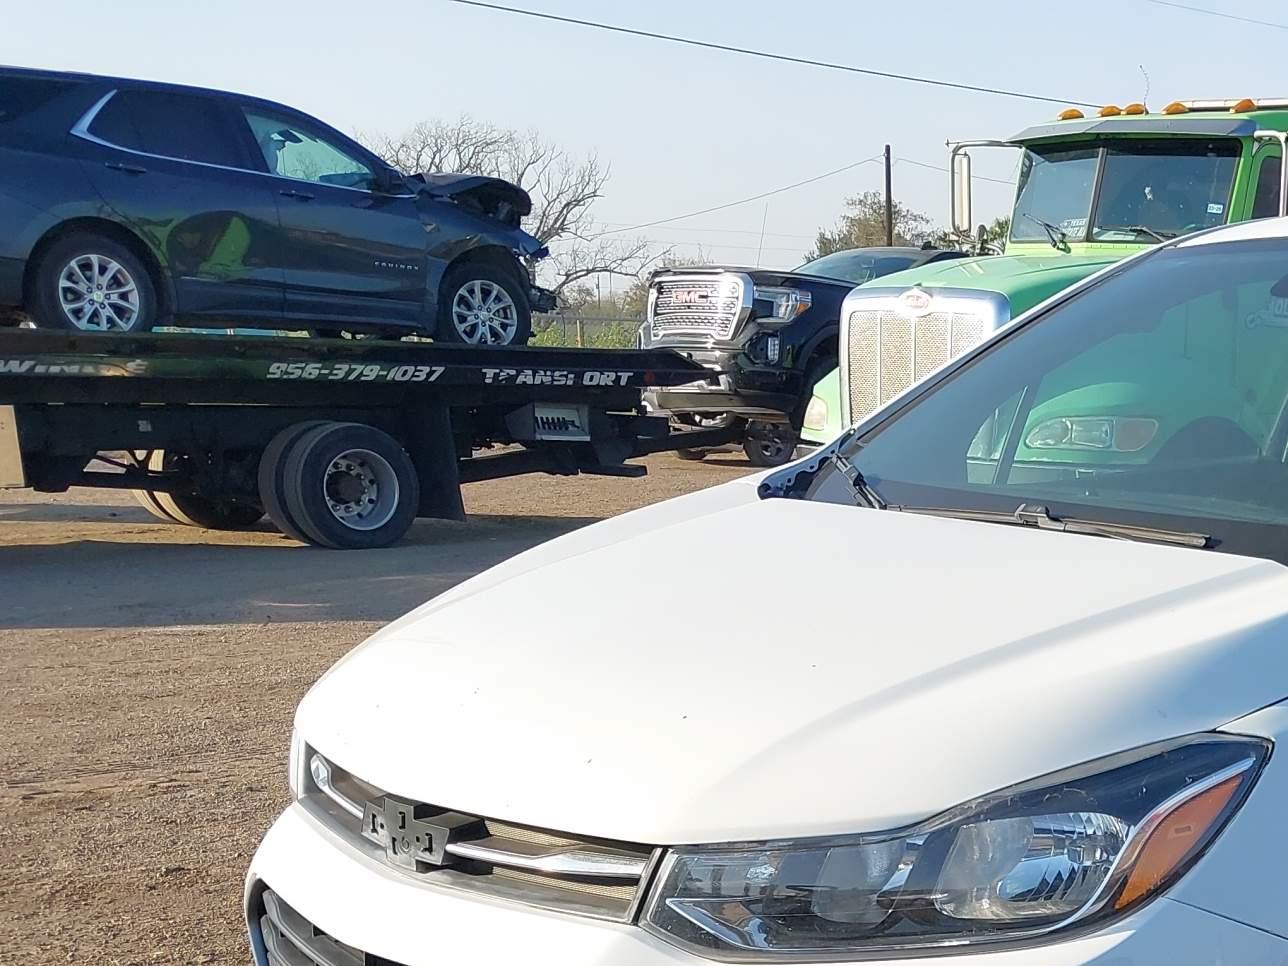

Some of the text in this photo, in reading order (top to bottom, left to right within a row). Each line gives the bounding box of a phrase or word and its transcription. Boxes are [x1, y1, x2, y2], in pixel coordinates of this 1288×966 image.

[673, 290, 707, 304] GMC
[266, 362, 446, 382] 956-379-1037
[481, 368, 634, 386] TRANSORT
